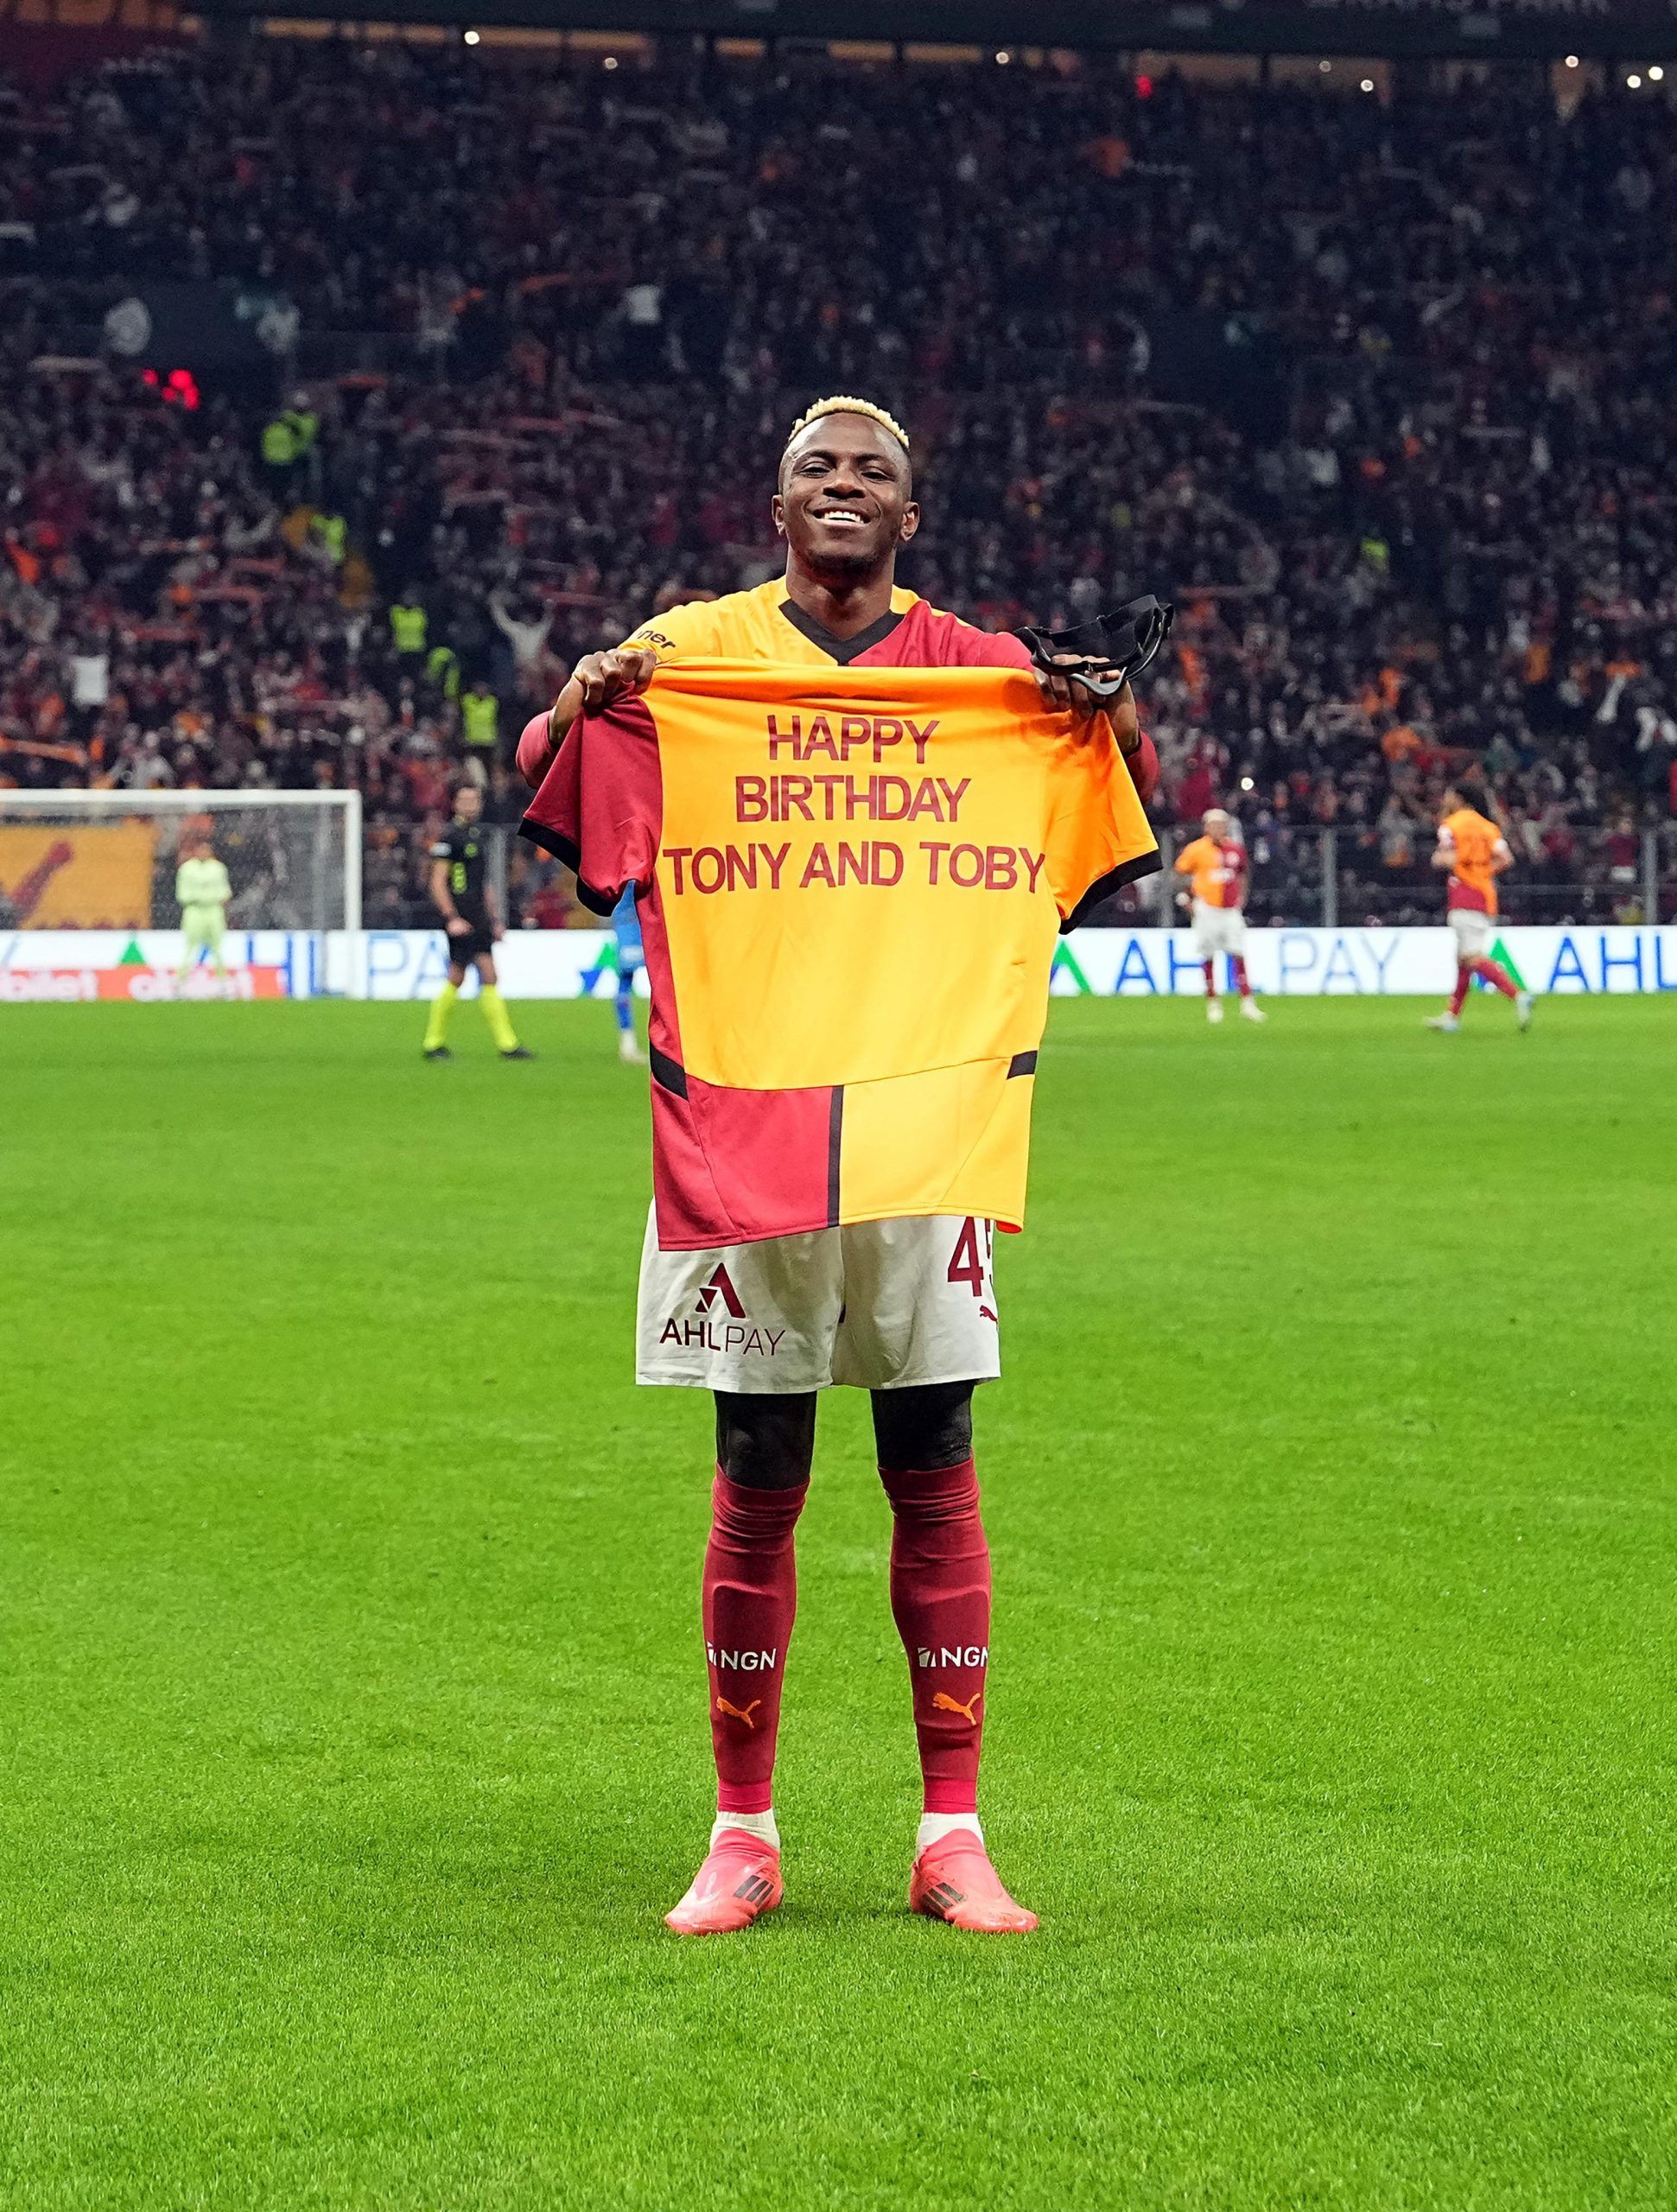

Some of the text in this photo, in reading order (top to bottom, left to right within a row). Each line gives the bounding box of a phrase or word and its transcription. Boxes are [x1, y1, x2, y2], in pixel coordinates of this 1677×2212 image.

[766, 714, 940, 764] HAPPY
[735, 775, 971, 823] BIRTHDAY
[663, 841, 1045, 895] TONY AND TOBY
[1548, 936, 1677, 993] AHL
[721, 1648, 777, 1670] NGN
